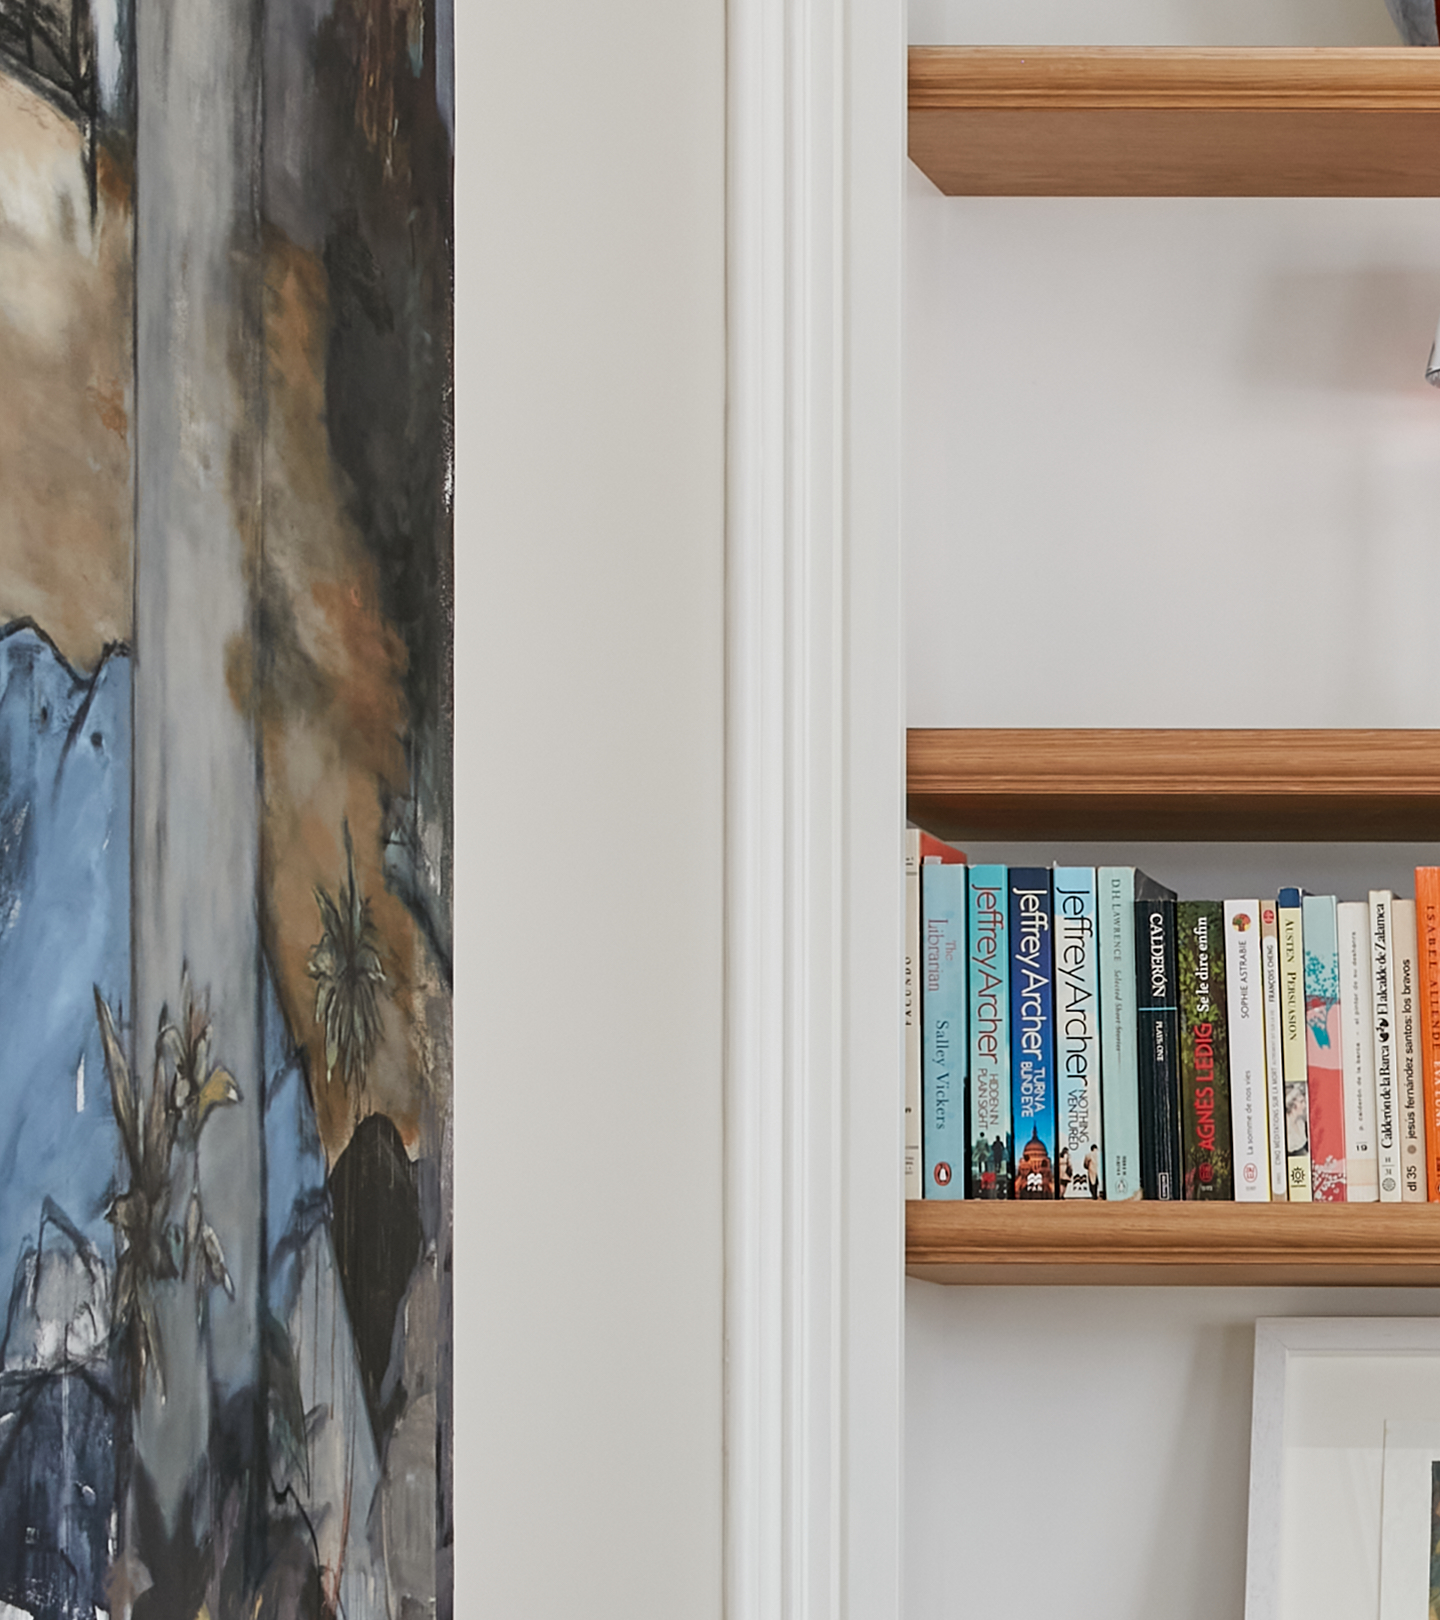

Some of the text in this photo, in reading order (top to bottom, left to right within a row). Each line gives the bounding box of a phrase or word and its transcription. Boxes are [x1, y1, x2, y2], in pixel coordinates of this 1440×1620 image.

[927, 919, 949, 992] Librarian
[945, 939, 957, 961] The
[1112, 903, 1123, 961] LAWRENCE
[1149, 912, 1169, 997] CALDERÓN
[1373, 903, 1385, 951] Zalamea
[1426, 905, 1439, 974] ISABEL
[972, 884, 1004, 1064] Jeffrey Archer
[1013, 888, 1049, 1061] Jeffrey Archer
[1057, 886, 1093, 1086] Jeffrey Archer
[1194, 917, 1210, 1012] Se le dire enfin
[1237, 940, 1250, 1019] SOPHIE ASTRABIE
[1266, 945, 1276, 1003] FRANÇOIS CHENG
[1285, 919, 1297, 1041] AUSTEN PERSUASION
[1375, 964, 1387, 1002] alcalde
[1376, 1005, 1387, 1016] El
[932, 1019, 950, 1130] Salley Vickers
[1377, 1045, 1390, 1077] Barca
[1400, 960, 1417, 1140] jesús fernández santos: los bravos
[977, 1068, 988, 1129] PLAIN SIGHT
[989, 1073, 999, 1111] HIDDEN
[1020, 1061, 1034, 1117] BLIND EYE
[1033, 1066, 1046, 1112] TURN A
[1078, 1089, 1089, 1143] NOTHING
[1193, 1023, 1215, 1151] AGNÈS LEDIG
[1379, 1089, 1390, 1100] de
[1067, 1089, 1079, 1151] VENTURED
[1379, 1101, 1393, 1148] Calderón
